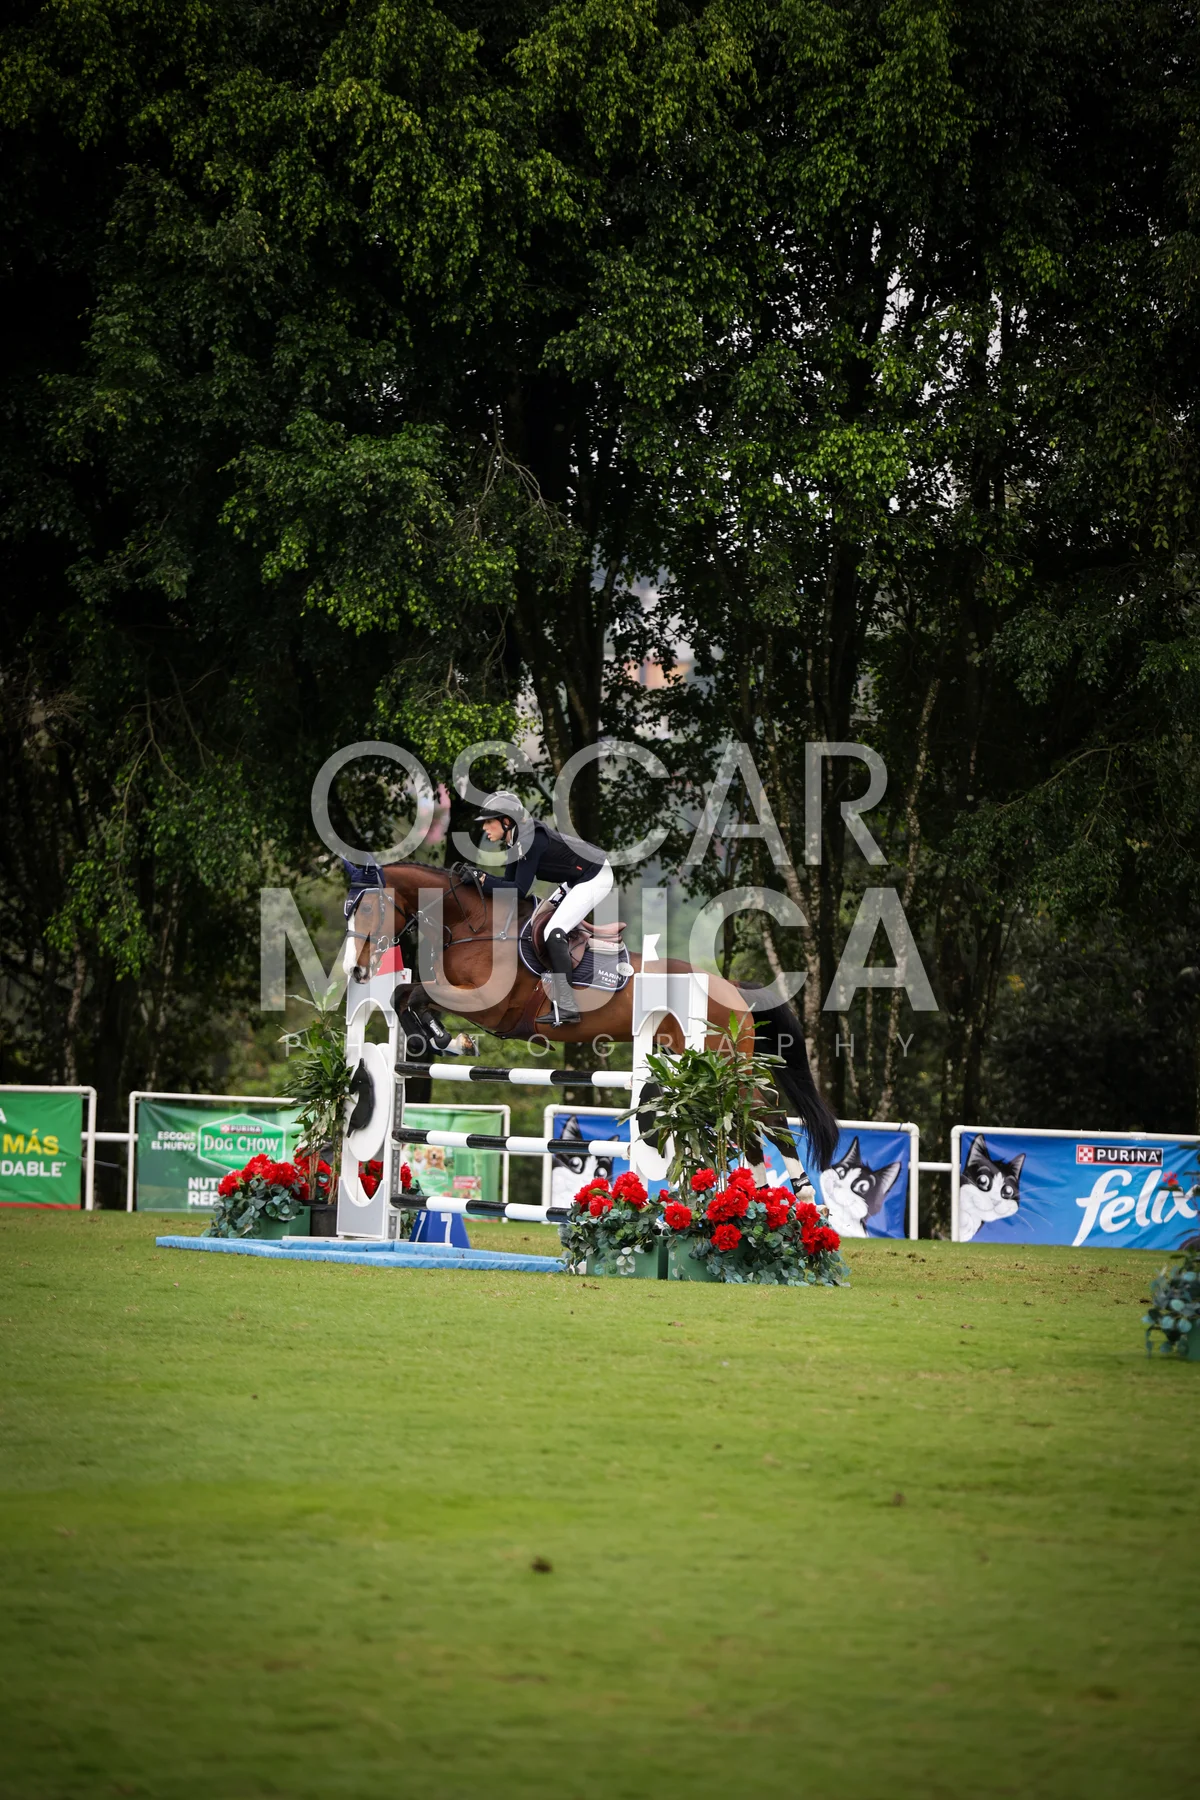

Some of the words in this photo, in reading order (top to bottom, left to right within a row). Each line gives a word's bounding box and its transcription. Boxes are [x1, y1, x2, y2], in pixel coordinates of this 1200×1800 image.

[3, 1128, 59, 1156] MÁS
[157, 1131, 196, 1141] ESCOGE
[151, 1141, 163, 1150] EL
[163, 1141, 196, 1151] NUEVO
[0, 1160, 66, 1177] DABLE
[188, 1176, 224, 1191] NUT
[188, 1191, 220, 1206] REF
[1072, 1168, 1200, 1246] felix
[440, 1212, 453, 1244] 7
